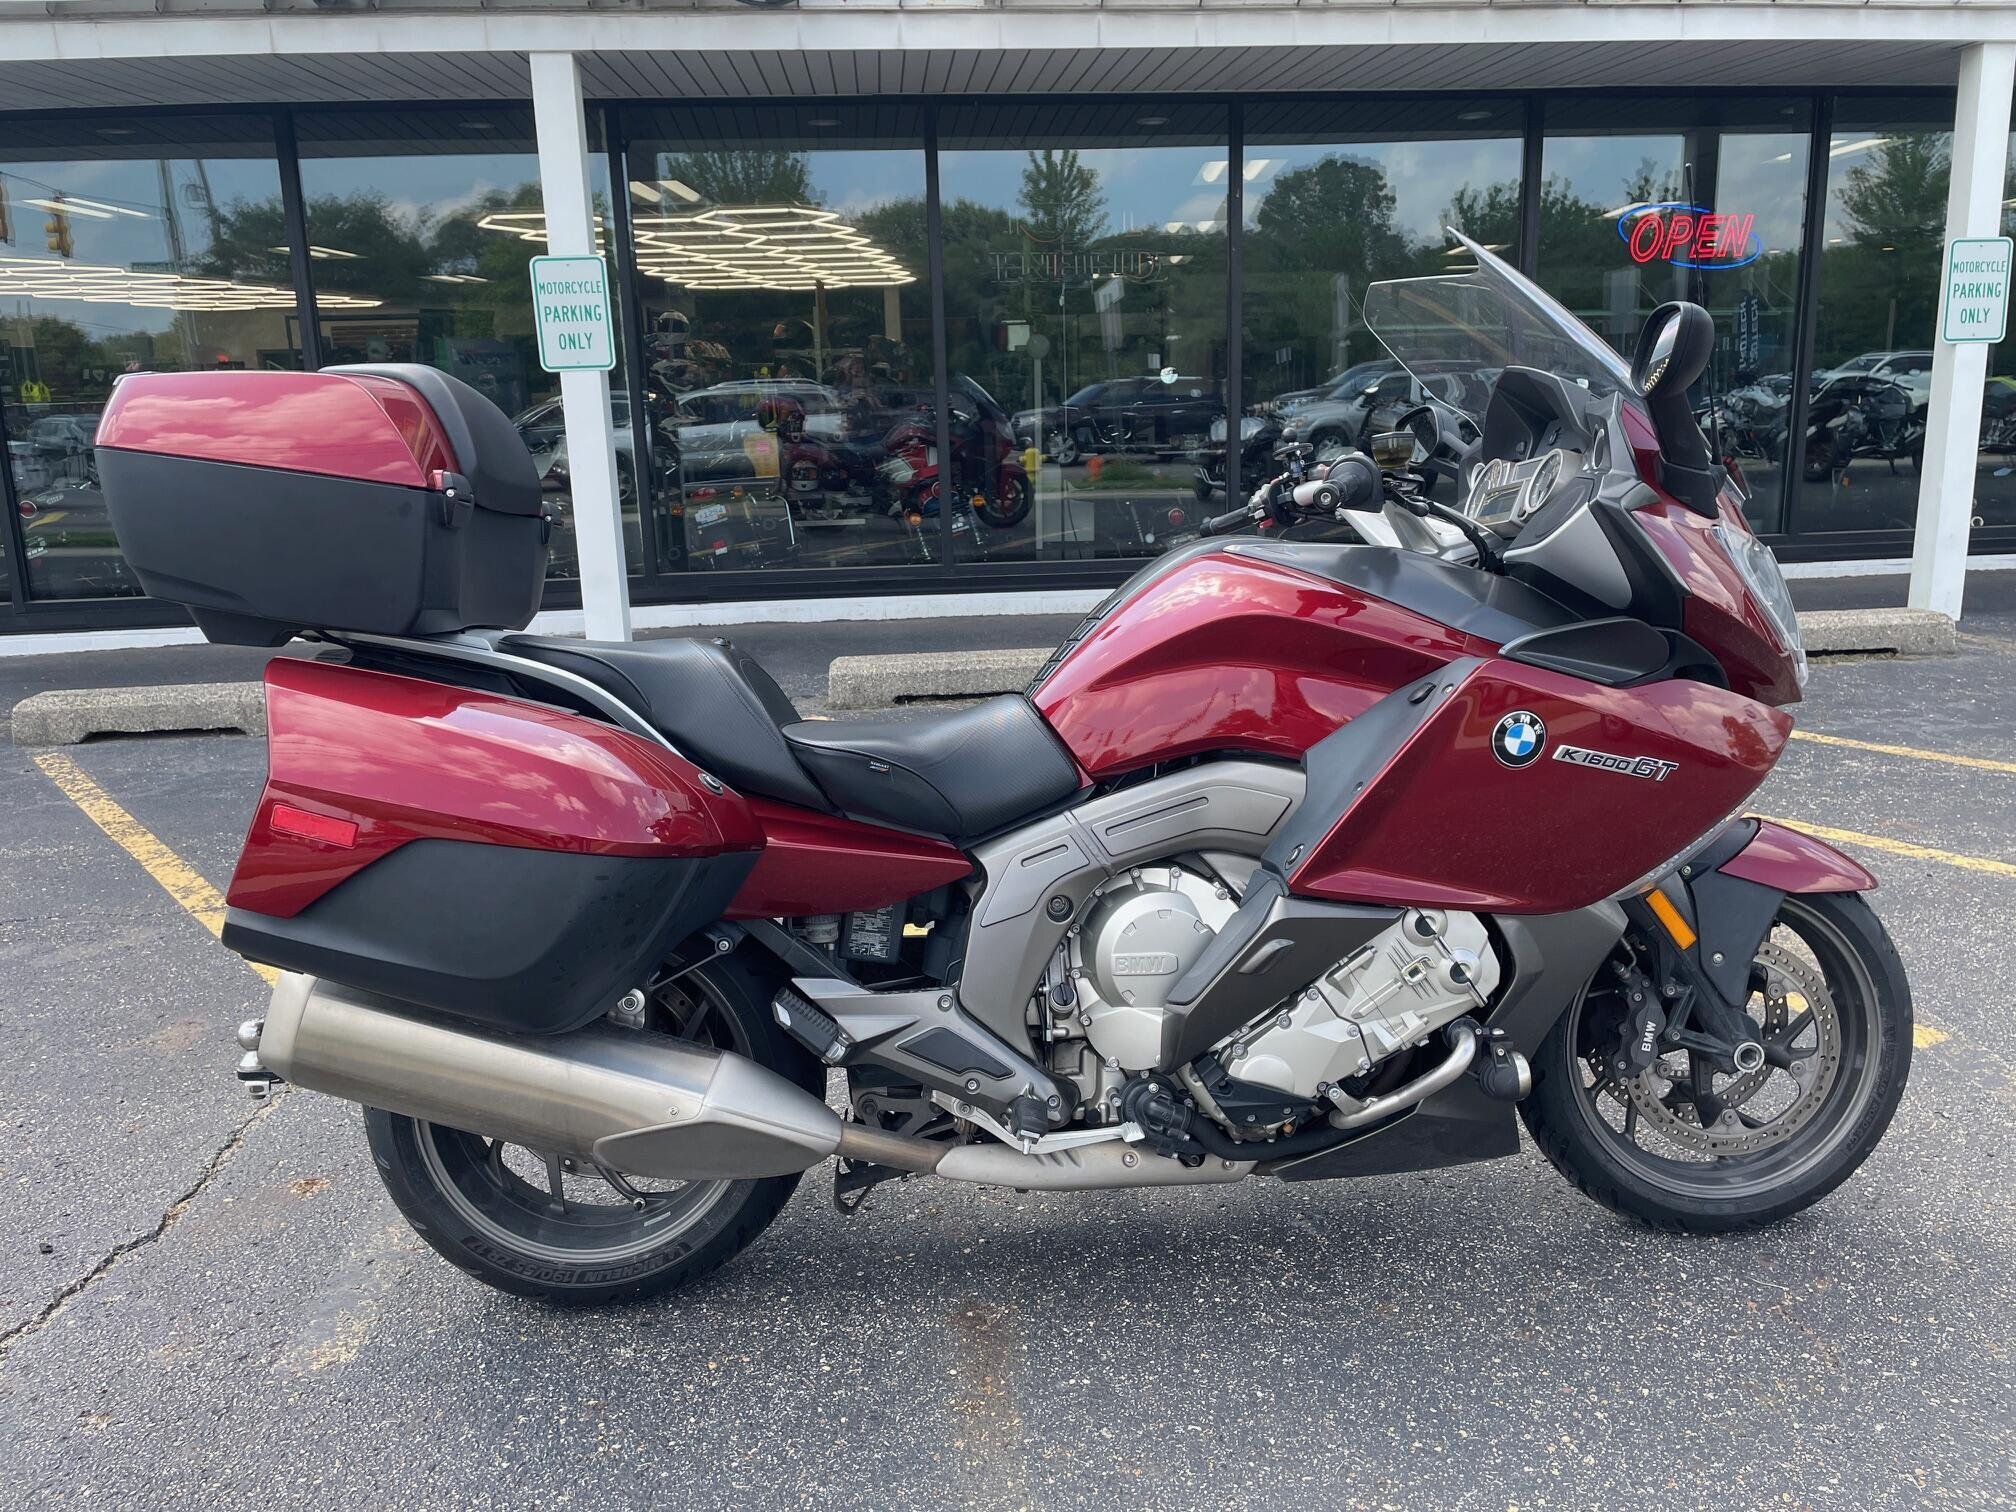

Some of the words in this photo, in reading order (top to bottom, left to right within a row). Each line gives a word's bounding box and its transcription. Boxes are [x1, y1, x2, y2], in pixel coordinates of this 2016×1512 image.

[1630, 213, 1754, 262] OPEN
[1953, 261, 2006, 272] MOTORCYCLE
[538, 281, 602, 294] MOTORCYCLE
[1953, 283, 2001, 298] PARKING
[544, 305, 602, 322] PARKING
[1960, 308, 1990, 323] ONLY
[558, 333, 592, 350] ONLY
[1503, 713, 1543, 735] BMW
[1115, 957, 1165, 973] BMW
[1641, 1020, 1657, 1052] BMW
[514, 1262, 572, 1282] 190/55
[584, 1253, 664, 1282] MICHELIN
